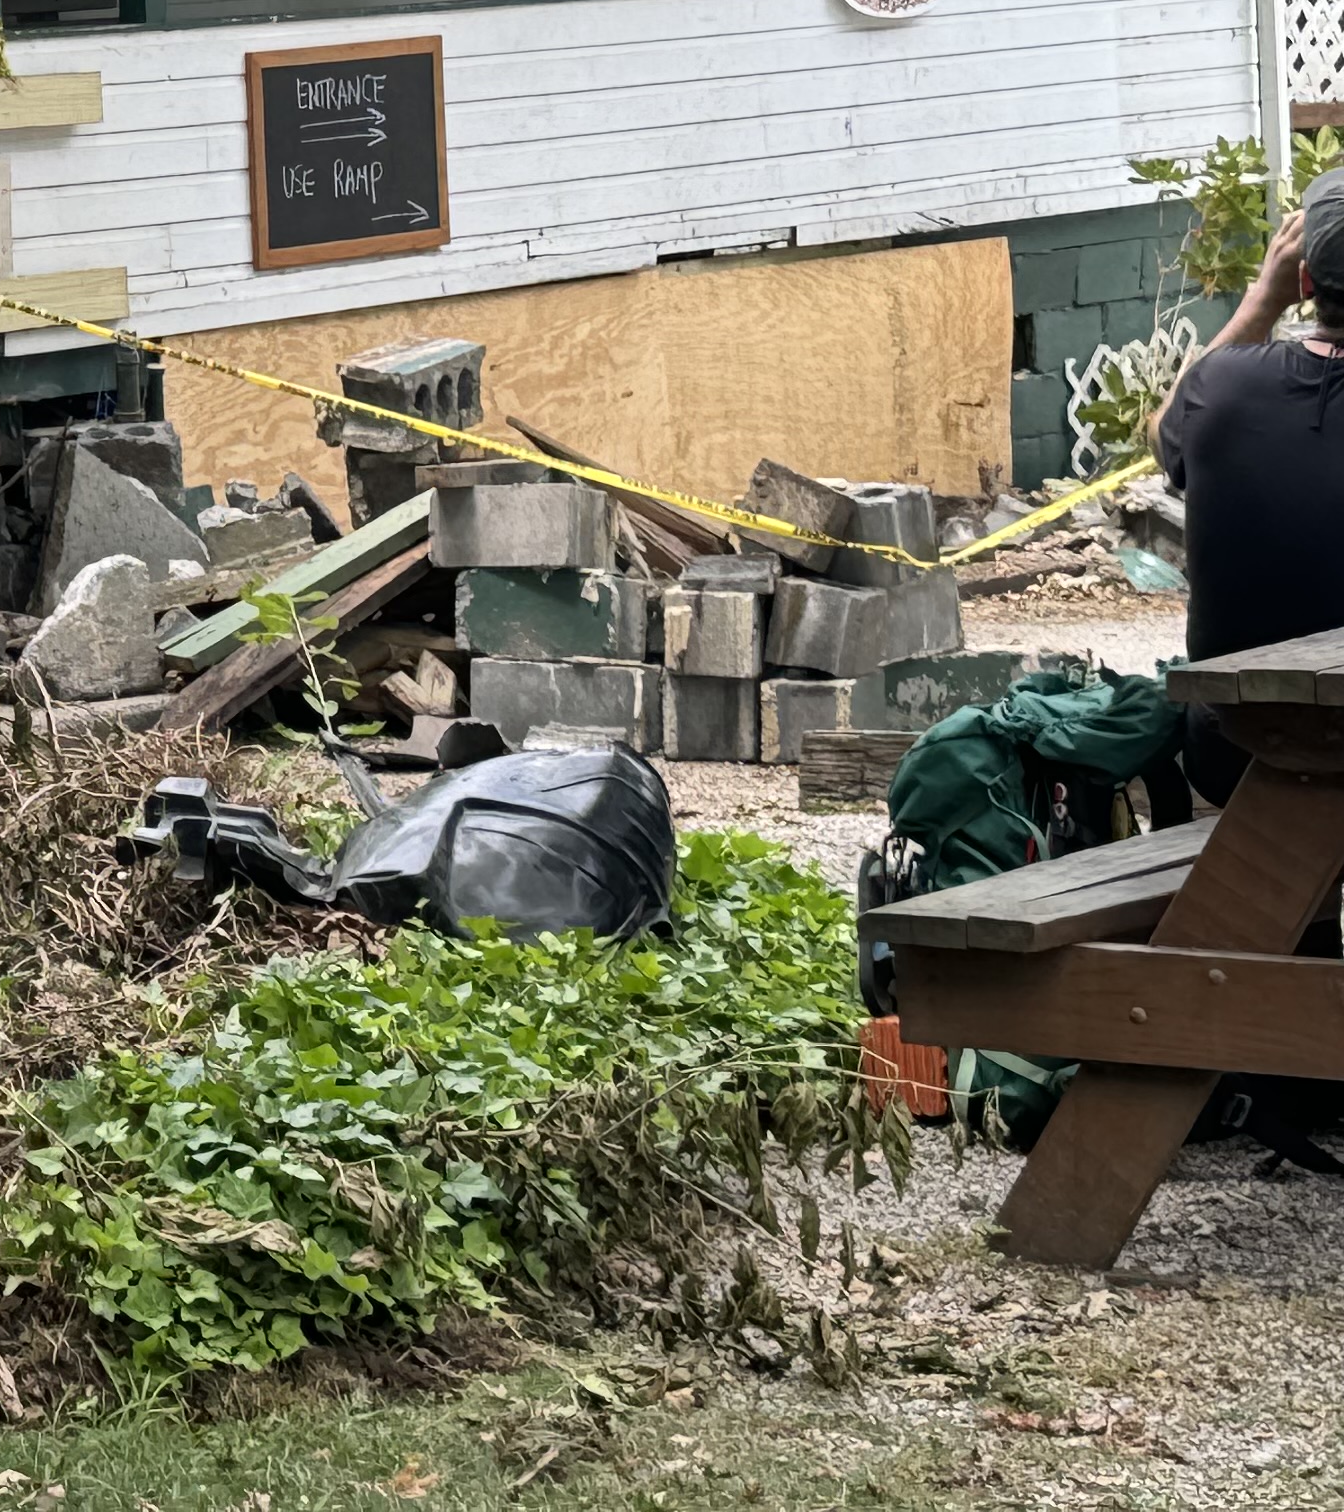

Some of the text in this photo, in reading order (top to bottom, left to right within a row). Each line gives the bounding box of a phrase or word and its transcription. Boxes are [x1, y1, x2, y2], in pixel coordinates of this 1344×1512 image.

[296, 74, 388, 110] ENTRANCE
[282, 158, 384, 204] USE RAMP
